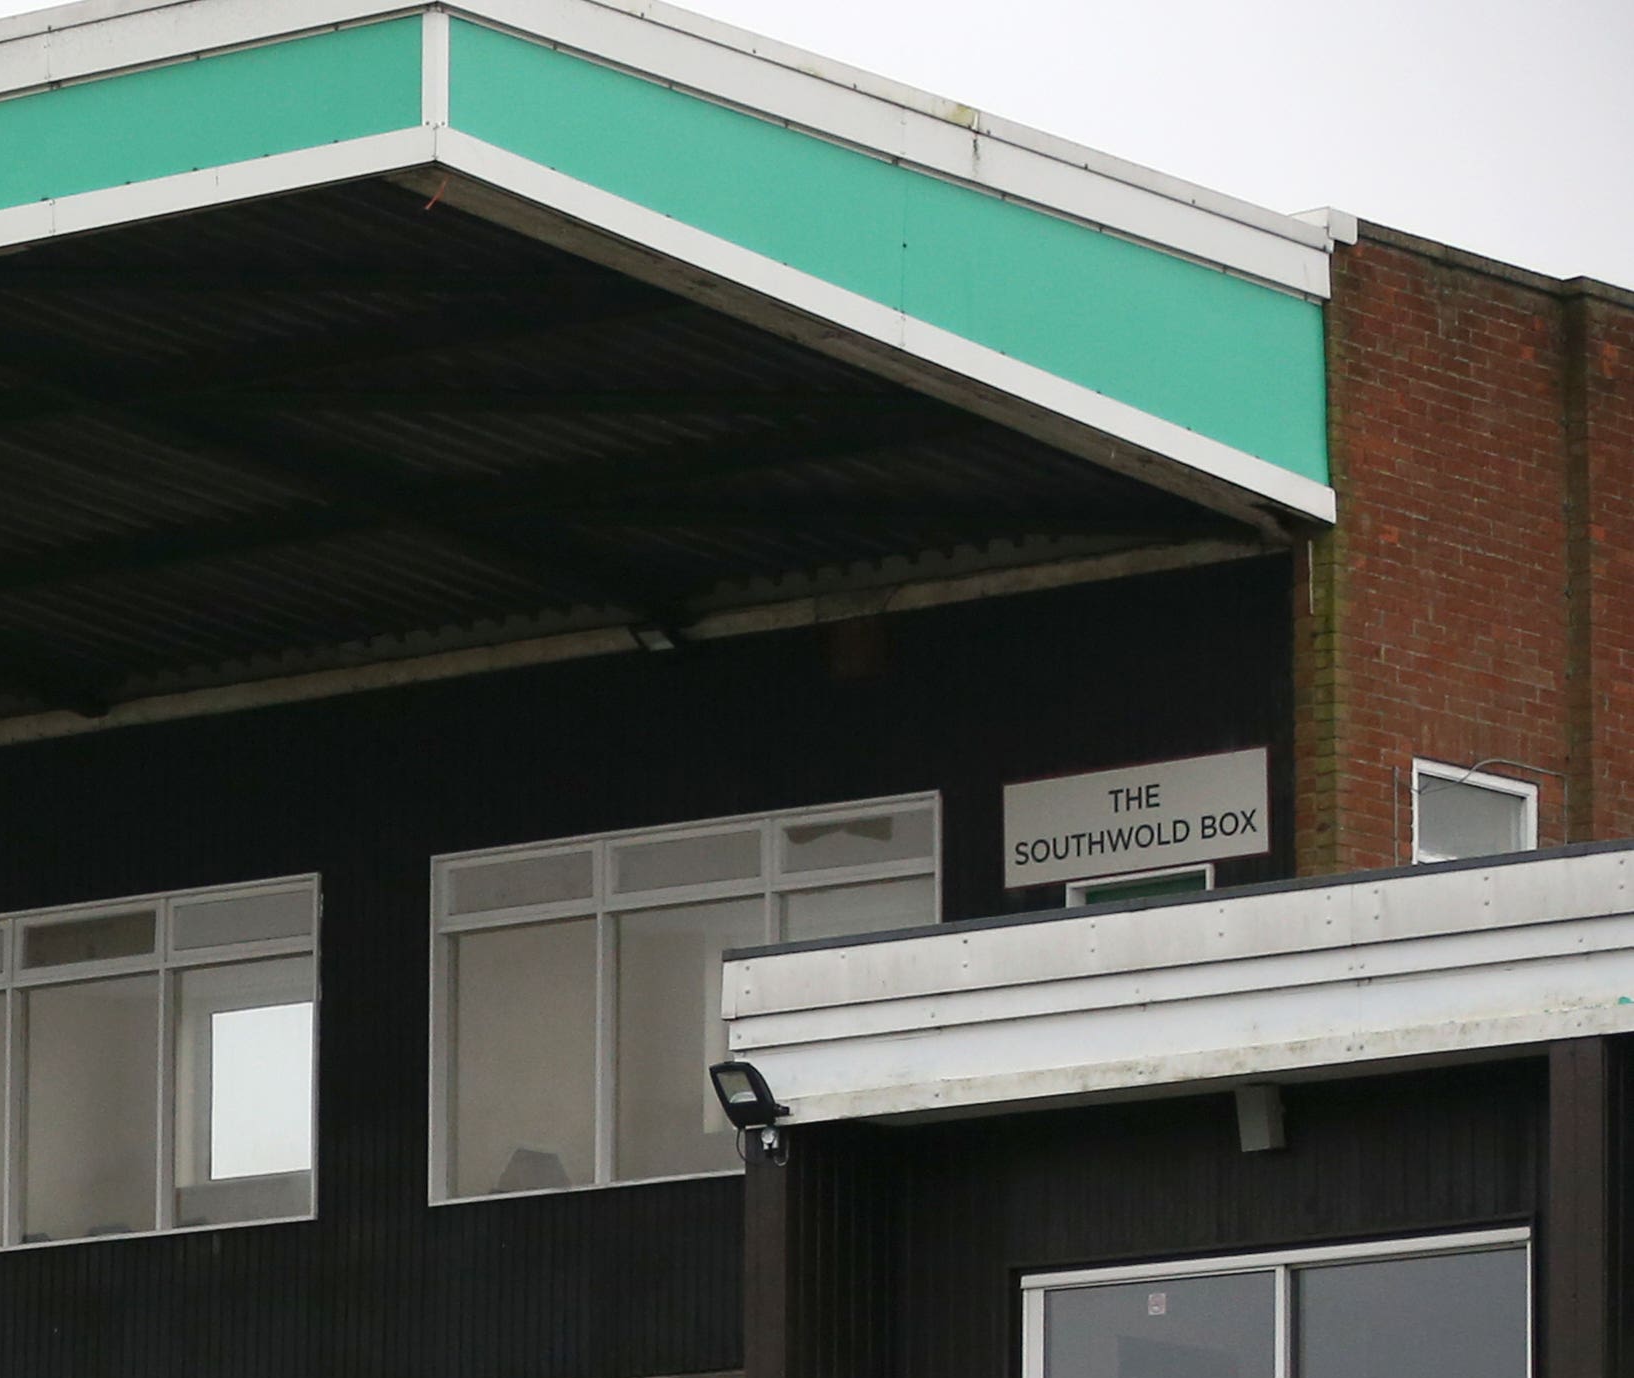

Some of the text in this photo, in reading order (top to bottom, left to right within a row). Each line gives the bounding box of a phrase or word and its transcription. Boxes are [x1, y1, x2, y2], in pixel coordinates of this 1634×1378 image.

[1108, 784, 1160, 813] THE
[1015, 808, 1257, 866] SOUTHWOLD BOX
